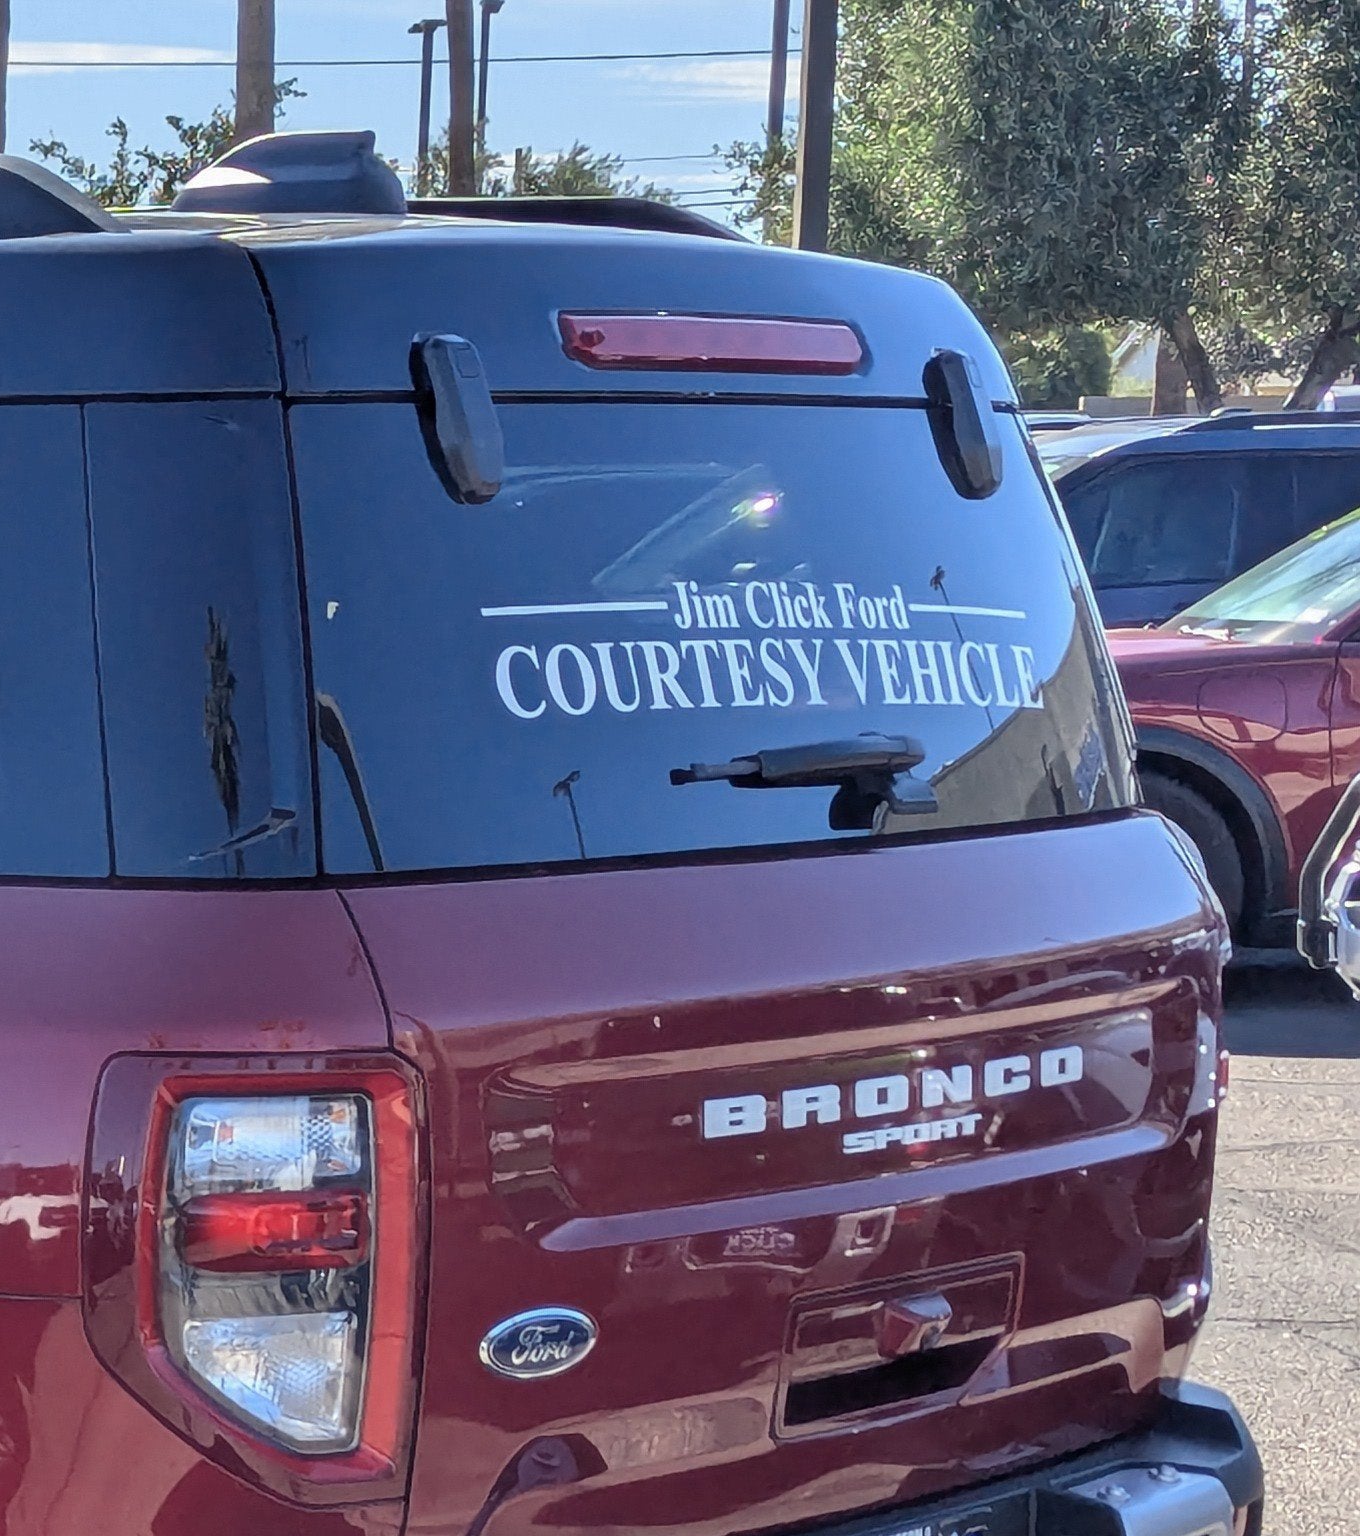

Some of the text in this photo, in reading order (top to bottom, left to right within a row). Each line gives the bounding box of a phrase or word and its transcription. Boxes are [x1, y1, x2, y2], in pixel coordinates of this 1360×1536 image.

[672, 580, 910, 631] Jim Click Ford
[495, 636, 1044, 719] COURTESY VEHICLE
[703, 1044, 1083, 1139] BRONCO
[842, 1113, 982, 1154] SPORT
[511, 1324, 575, 1366] Ford
